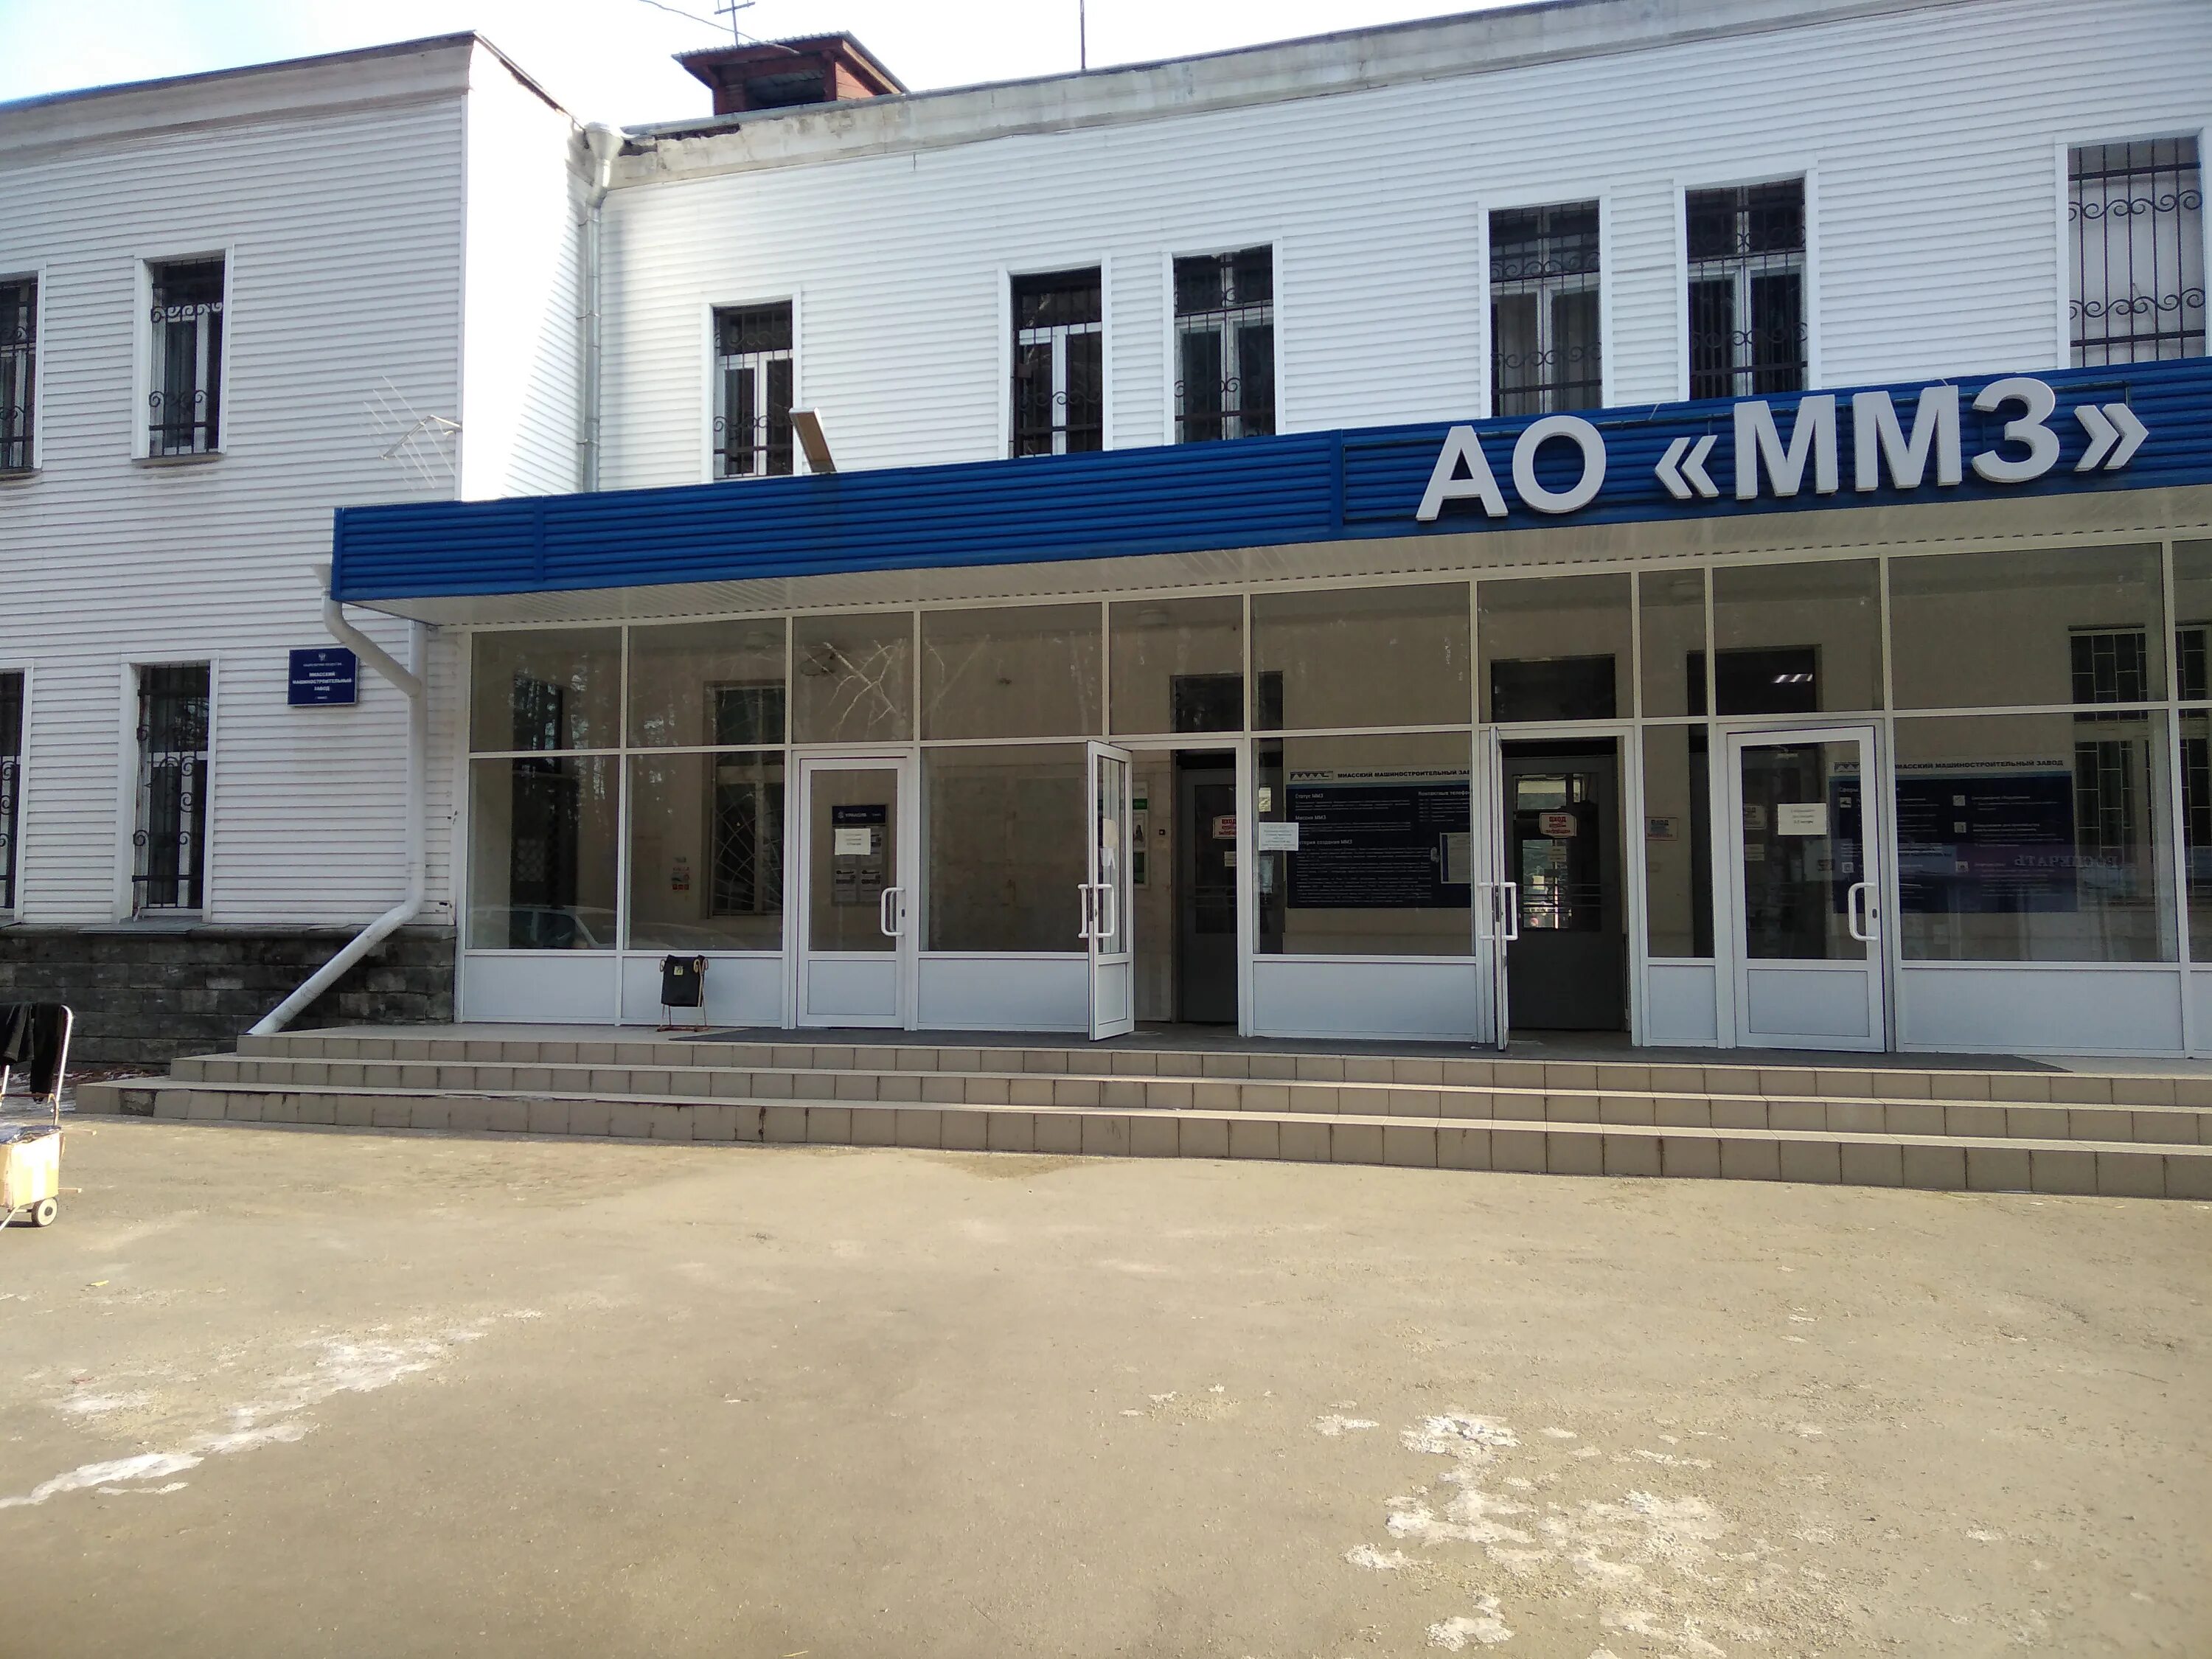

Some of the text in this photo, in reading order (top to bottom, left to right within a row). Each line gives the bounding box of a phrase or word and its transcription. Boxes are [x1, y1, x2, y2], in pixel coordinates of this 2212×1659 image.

[1416, 377, 2150, 521] АО «ММЗ»
[1935, 760, 2034, 768] МАШИНОСТРОИТЕЛЬНЫЙ
